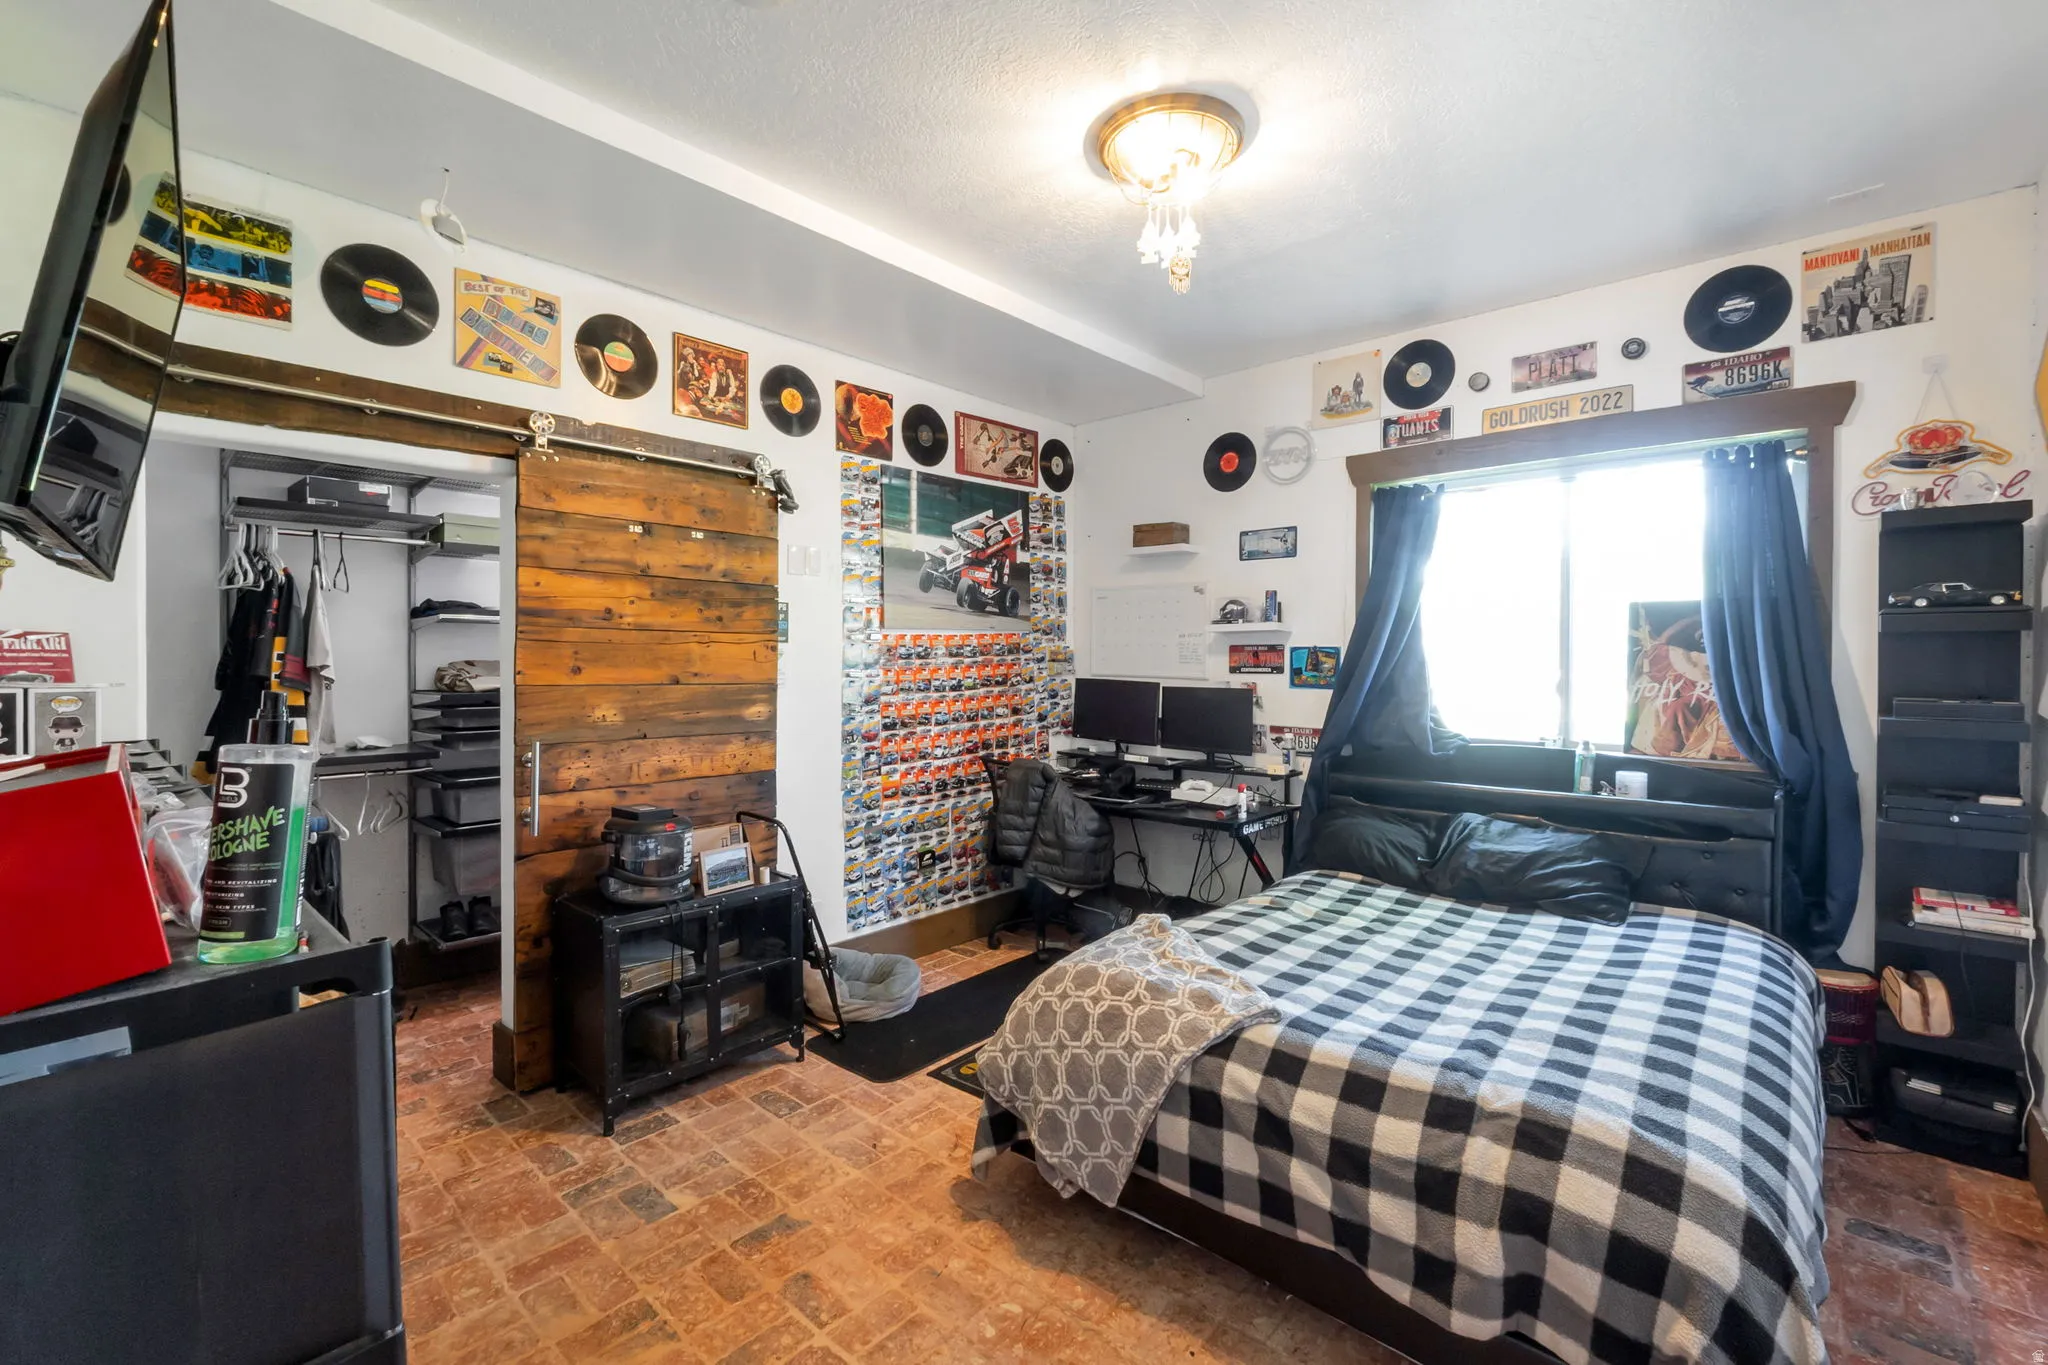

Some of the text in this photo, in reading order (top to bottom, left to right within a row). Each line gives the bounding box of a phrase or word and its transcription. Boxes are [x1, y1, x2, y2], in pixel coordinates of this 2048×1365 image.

[1804, 232, 1931, 272] MANTOVANI MANHATTAN
[464, 281, 529, 298] BEST OF THE
[1724, 353, 1763, 366] IDAHO
[1724, 359, 1783, 386] 8696K
[1489, 391, 1624, 429] GOLDRUSH 2022
[1393, 419, 1440, 439] TUANIS
[1243, 820, 1263, 835] GAME
